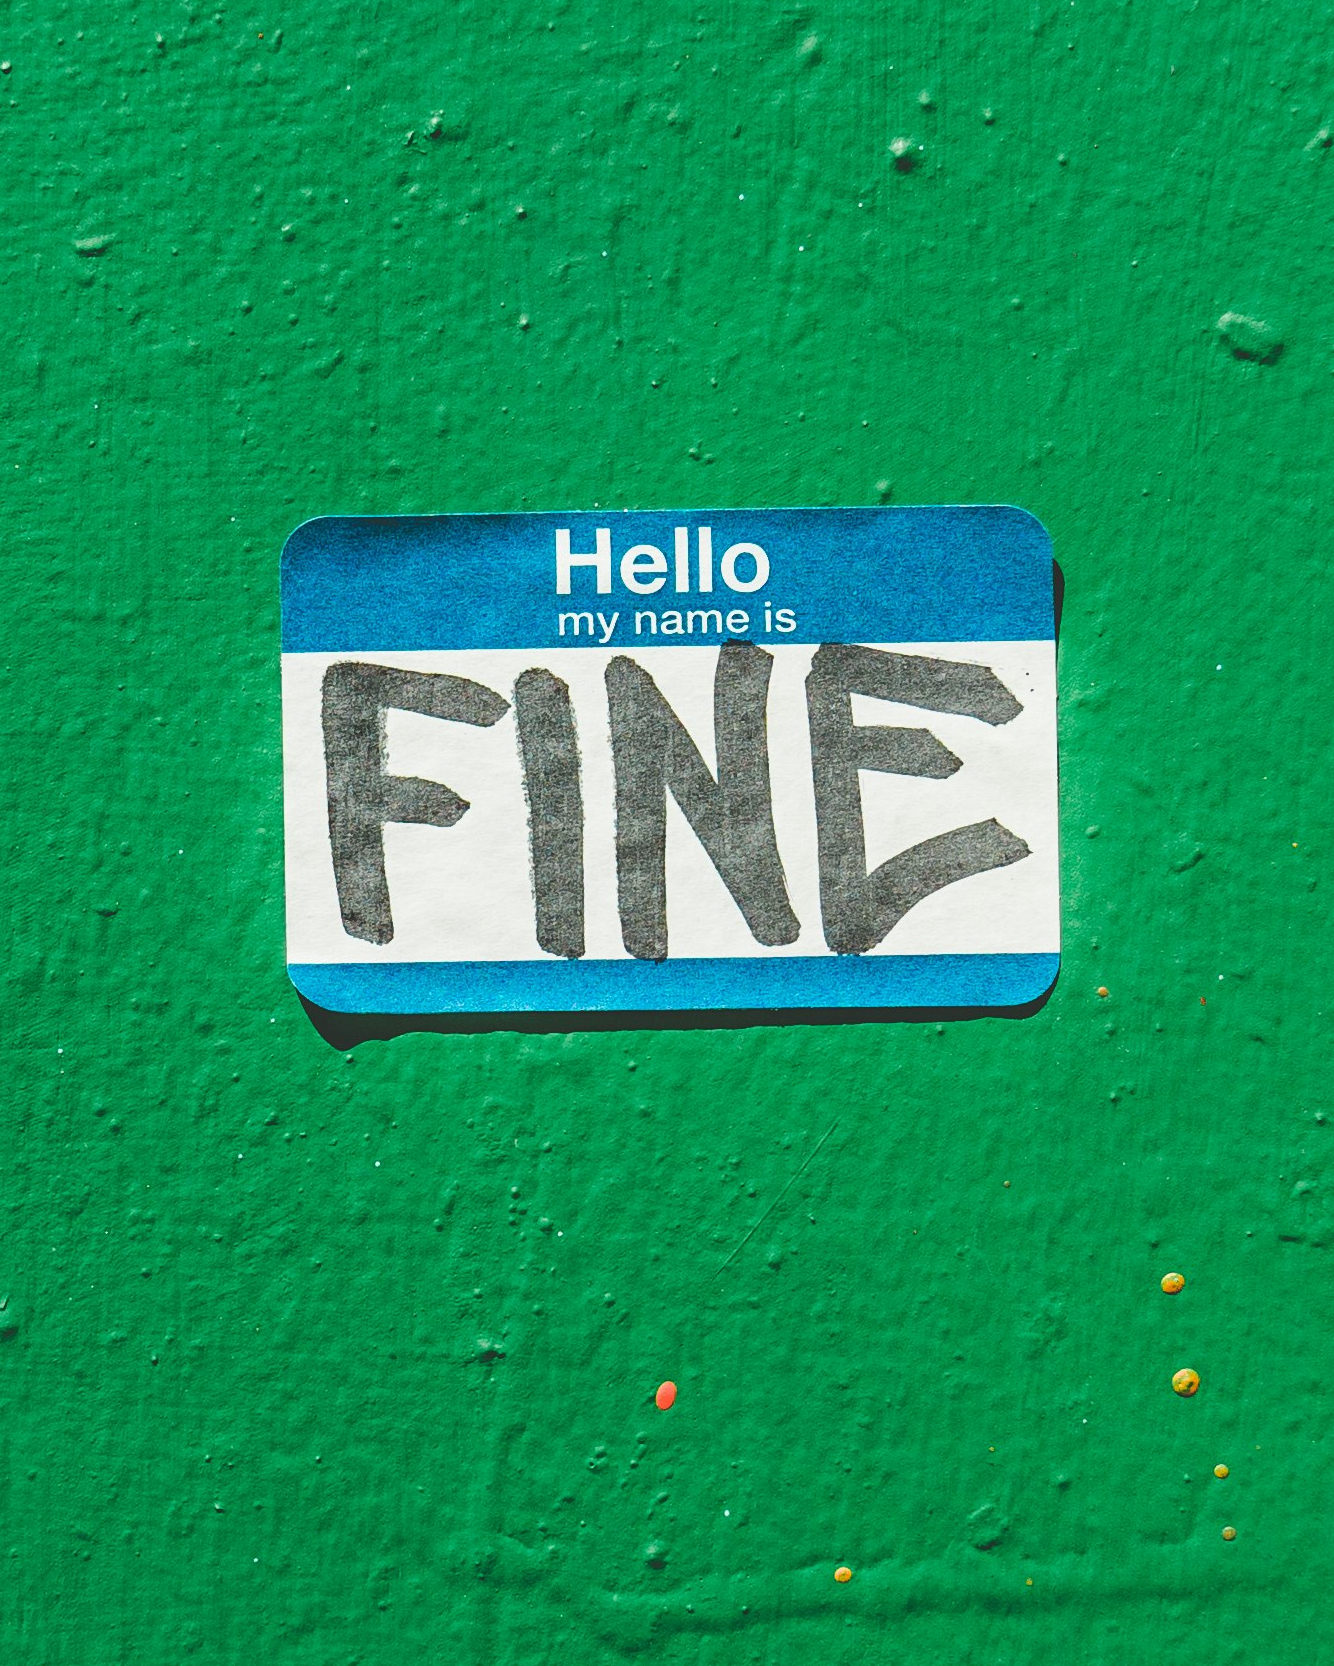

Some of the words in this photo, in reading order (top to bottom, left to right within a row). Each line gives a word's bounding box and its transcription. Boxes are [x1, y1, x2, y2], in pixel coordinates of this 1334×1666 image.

[555, 526, 770, 595] Hello
[558, 611, 620, 644] my
[635, 609, 750, 635] name
[764, 601, 798, 633] is
[321, 640, 1034, 963] FINE
